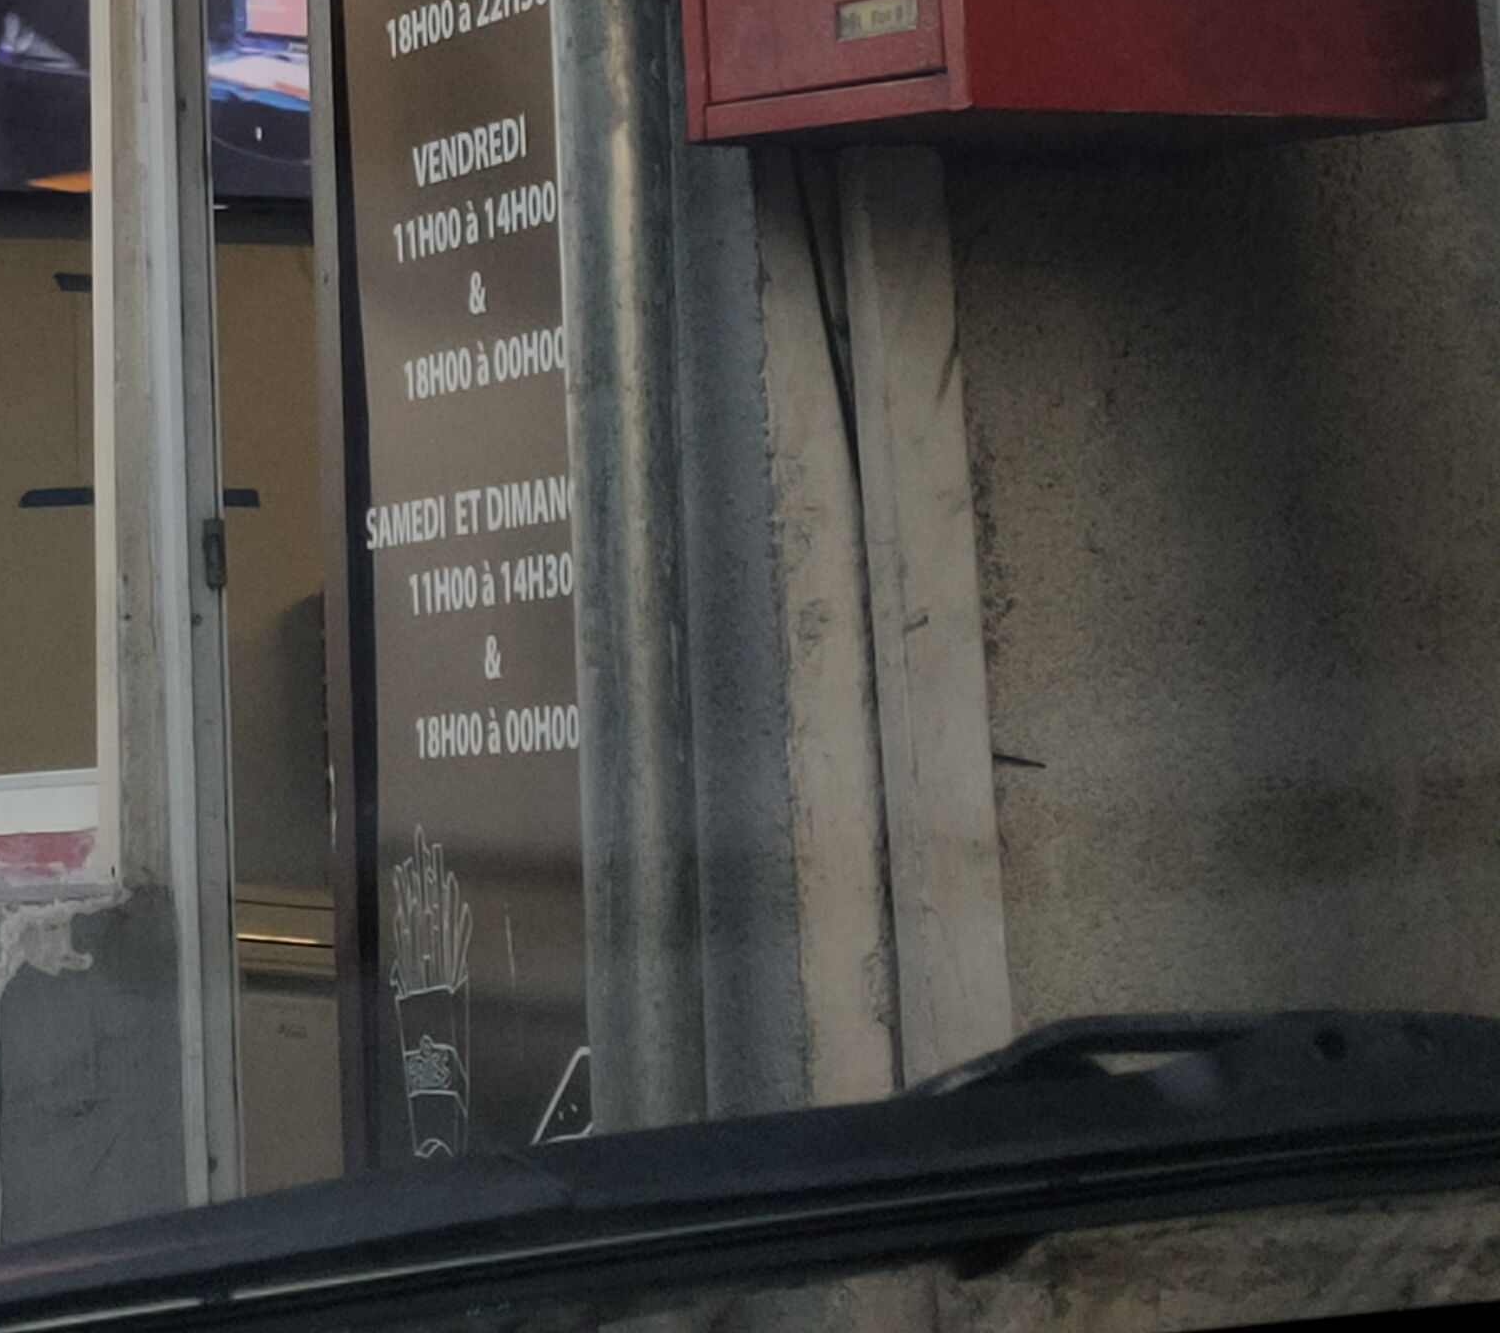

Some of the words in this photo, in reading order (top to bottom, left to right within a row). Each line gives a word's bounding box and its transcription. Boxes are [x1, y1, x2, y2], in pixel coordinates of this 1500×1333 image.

[386, 0, 454, 59] 18H00
[412, 115, 527, 188] VENDREDI
[393, 207, 462, 262] 11H00
[465, 201, 479, 244] à
[484, 180, 557, 240] 14H00
[468, 271, 487, 315] &
[404, 347, 472, 401] 18H00
[476, 340, 490, 386] à
[366, 496, 446, 550] SAMEDI
[455, 489, 481, 536] ET
[409, 565, 477, 616] 11H00
[482, 560, 496, 606] à
[500, 552, 573, 605] 14H30
[484, 635, 502, 680] &
[416, 712, 483, 759] 18H00
[487, 707, 501, 754] à
[505, 704, 580, 753] 00H00
